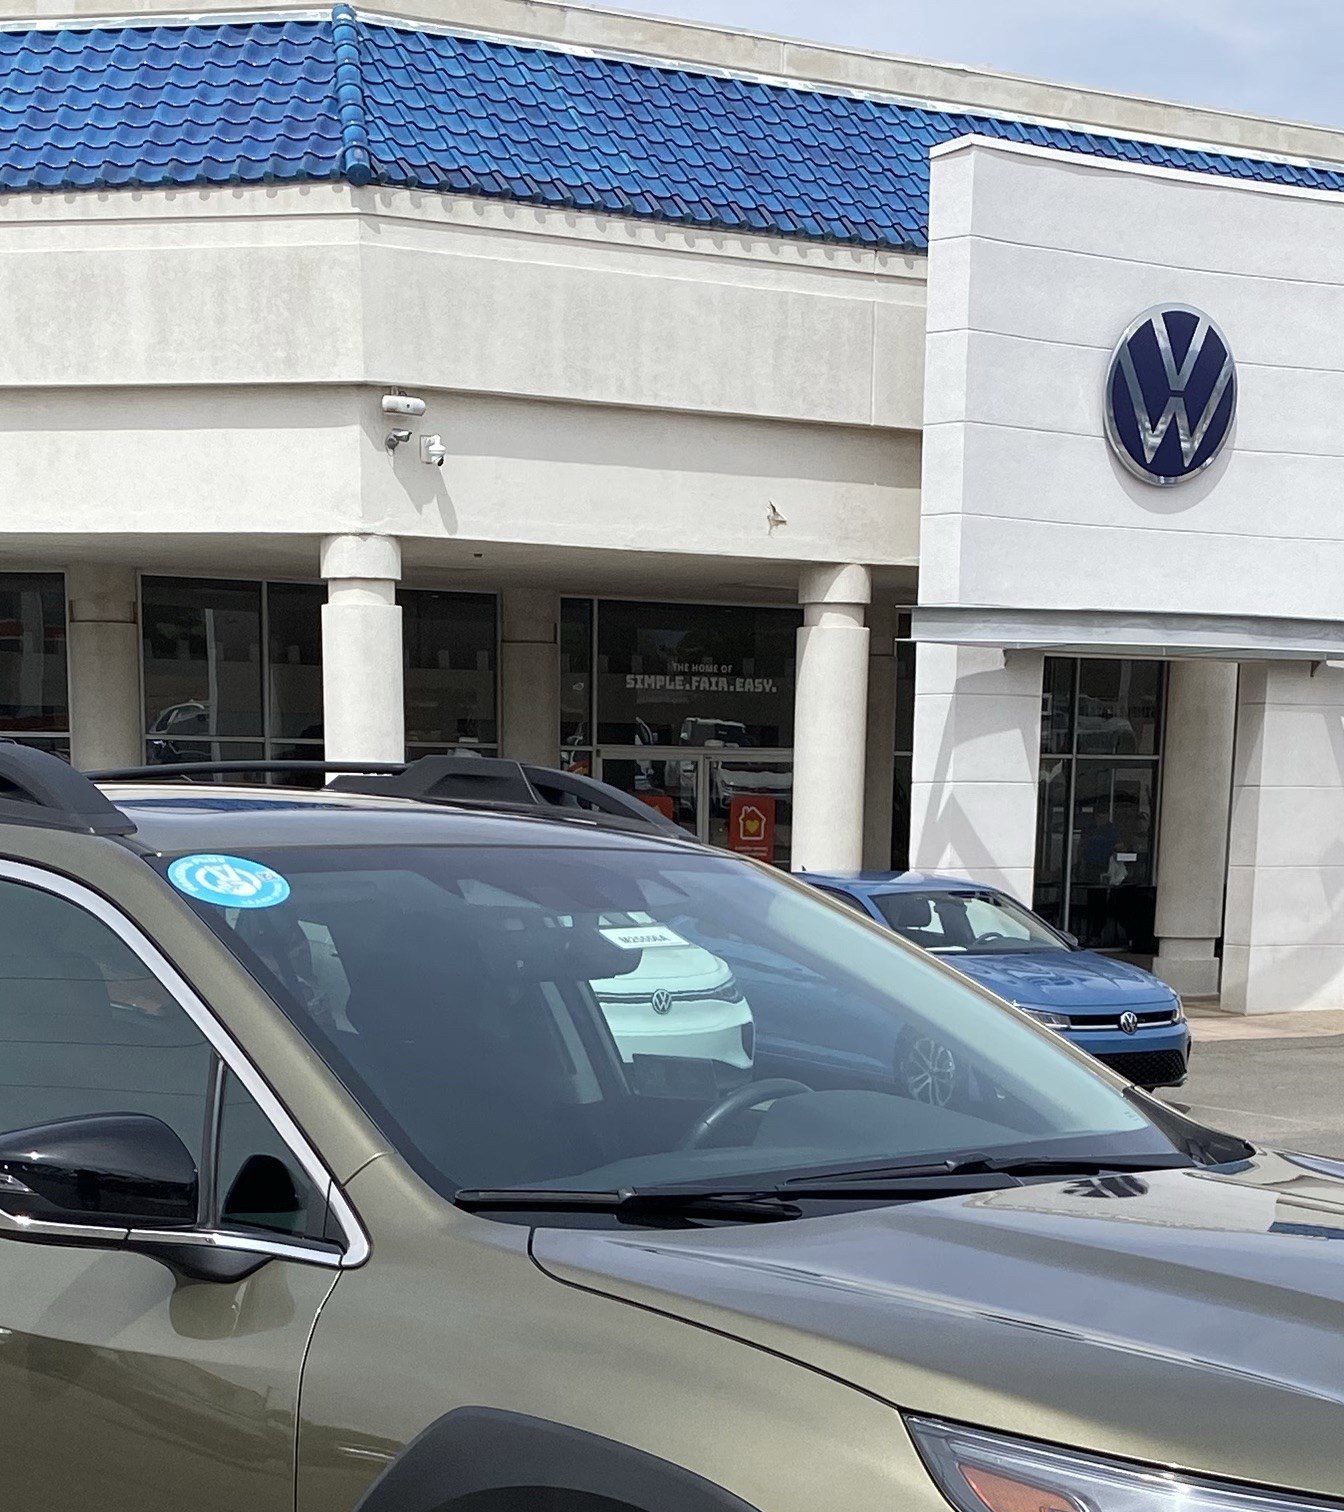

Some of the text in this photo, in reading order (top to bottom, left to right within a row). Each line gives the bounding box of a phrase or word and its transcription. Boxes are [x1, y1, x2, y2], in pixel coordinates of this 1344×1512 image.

[1107, 306, 1236, 480] VW
[672, 662, 733, 674] THE HOME OF
